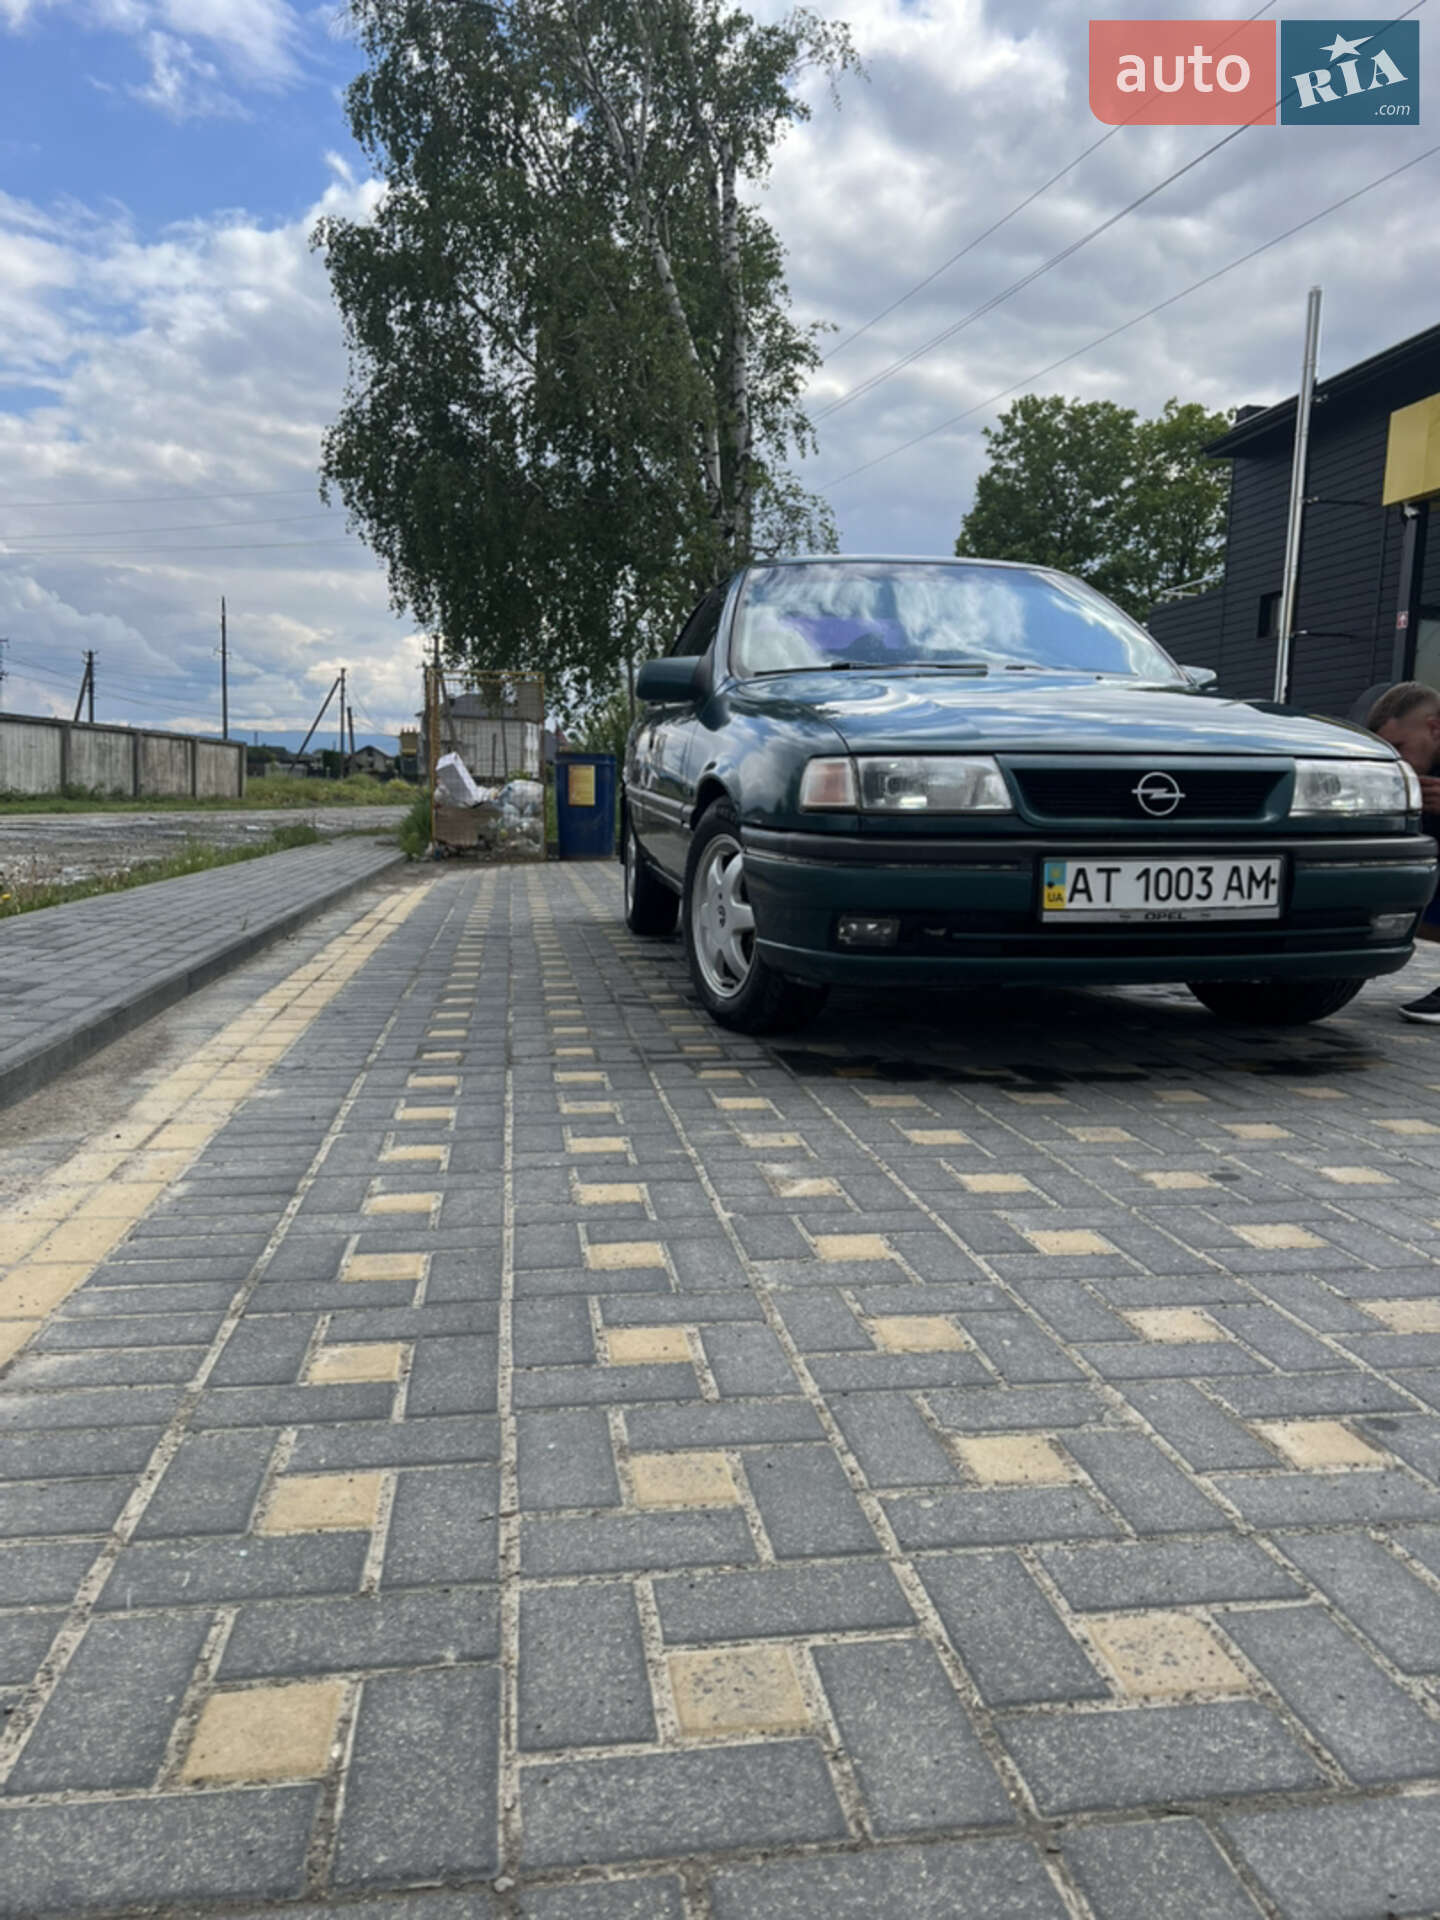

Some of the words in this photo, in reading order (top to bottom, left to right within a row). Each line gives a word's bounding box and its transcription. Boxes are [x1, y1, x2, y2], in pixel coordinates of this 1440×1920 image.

[1068, 866, 1121, 903] AT
[1135, 866, 1214, 902] 1003
[1223, 865, 1273, 901] AM
[1047, 891, 1064, 903] UA
[1144, 911, 1187, 921] OPEL
